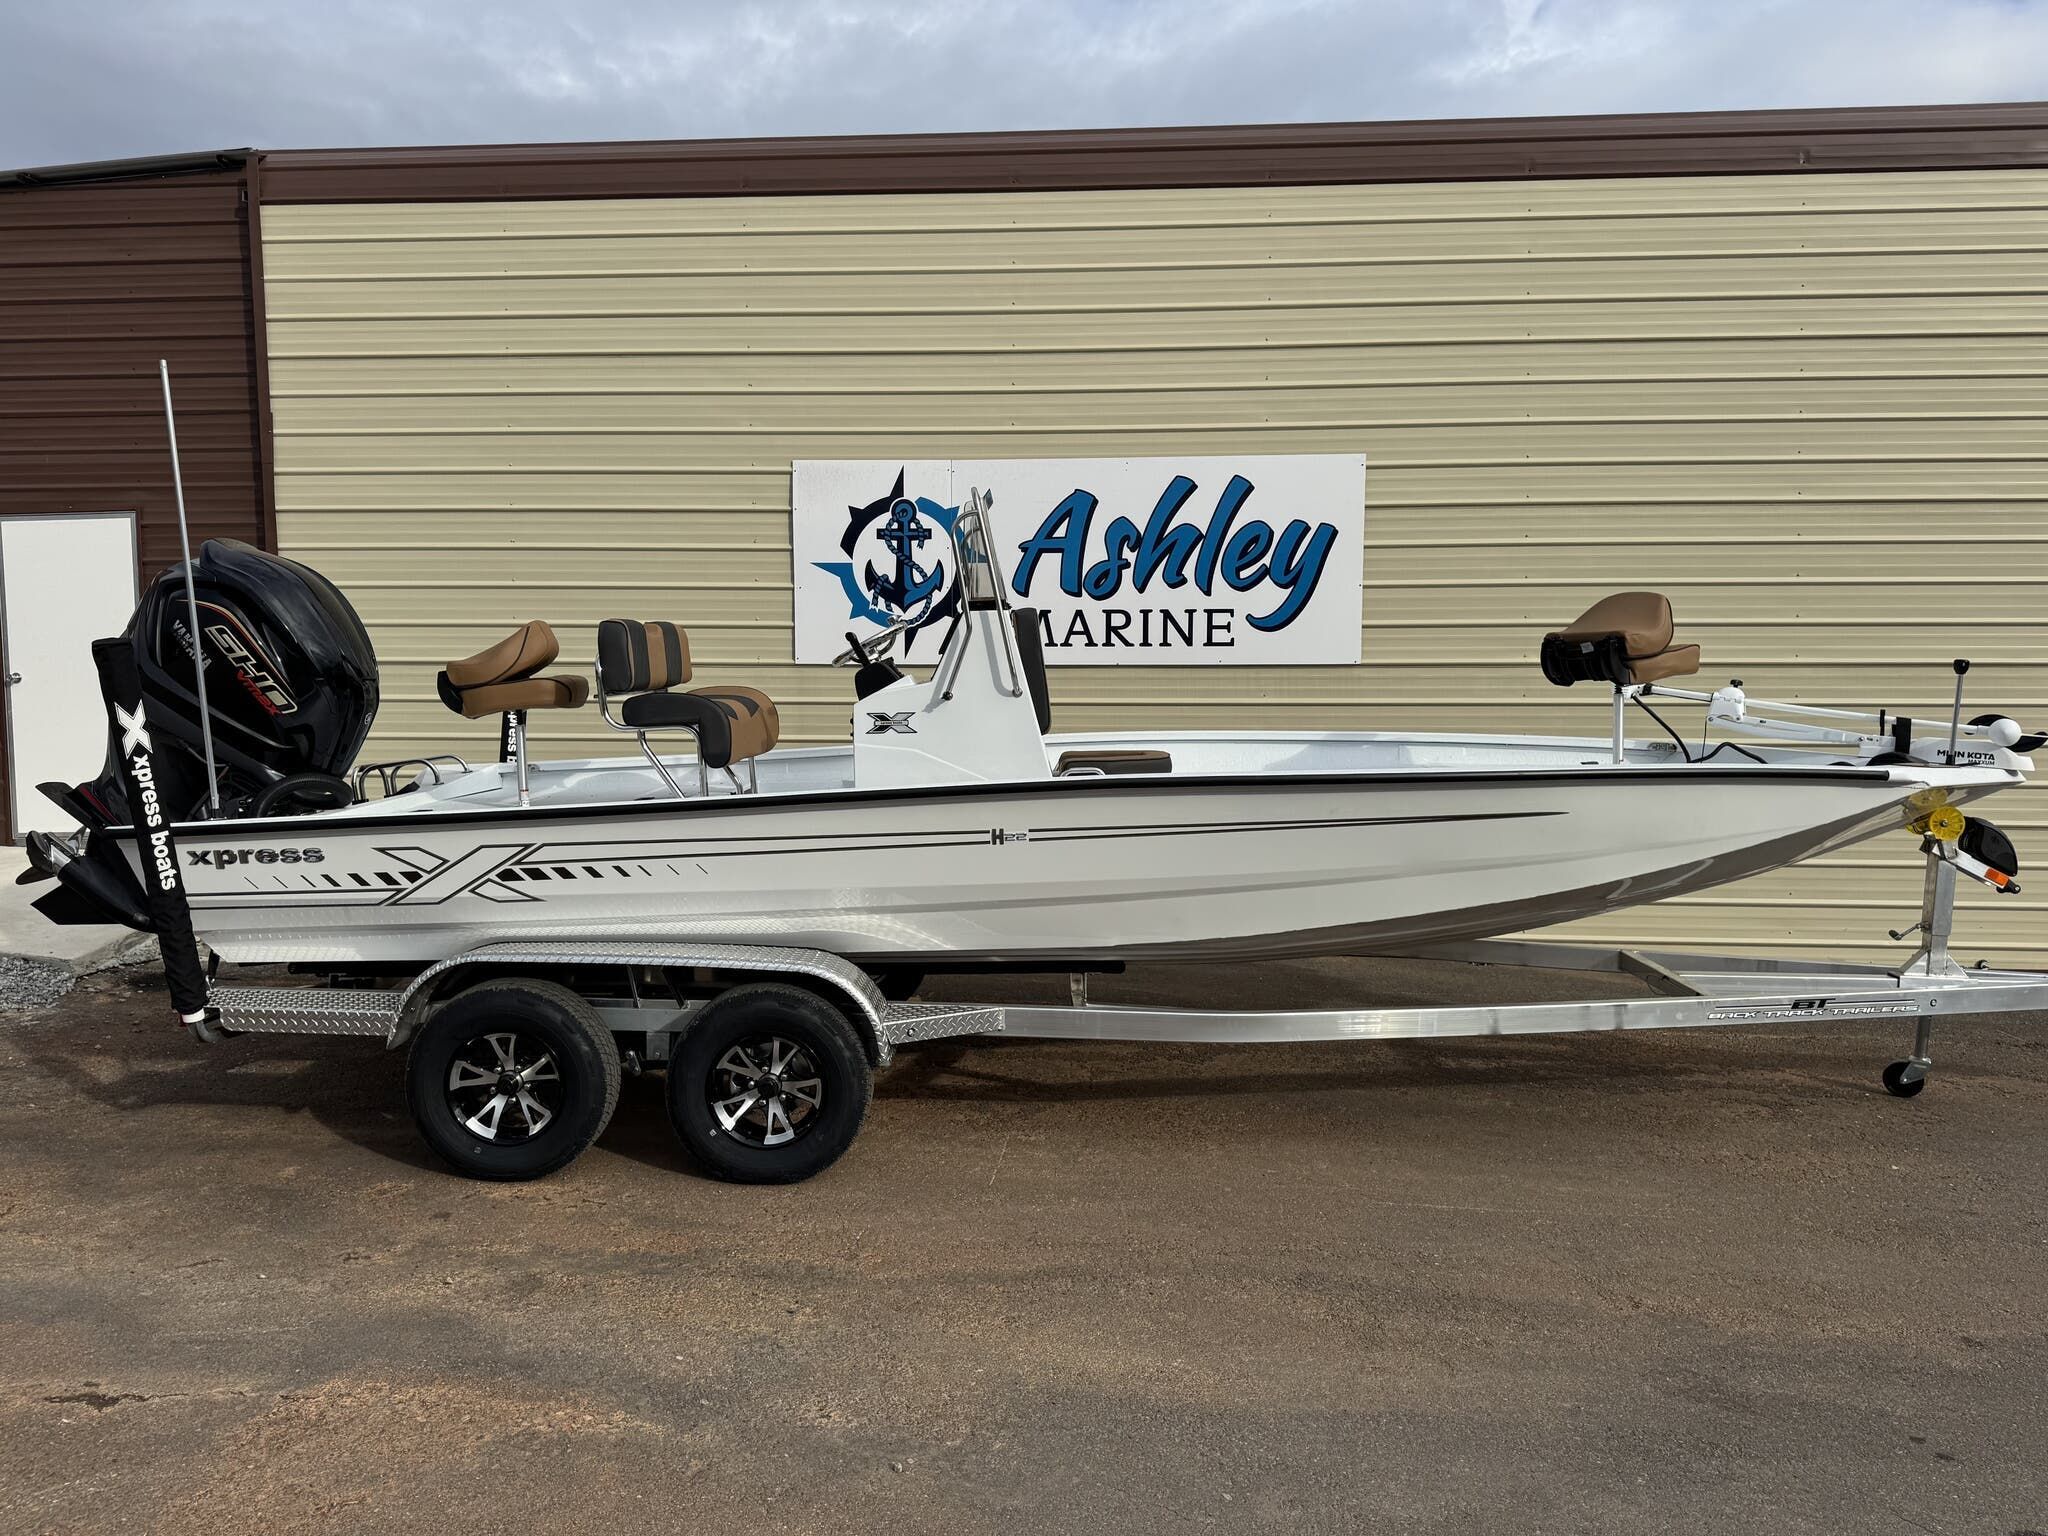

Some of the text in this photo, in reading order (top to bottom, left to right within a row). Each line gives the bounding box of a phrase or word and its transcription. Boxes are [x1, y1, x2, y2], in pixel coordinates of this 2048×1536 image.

[1011, 474, 1339, 632] Ashley
[204, 624, 298, 714] SHO
[1967, 751, 1995, 761] KOTA
[131, 753, 178, 891] xpress boats
[991, 828, 1027, 846] H22
[186, 847, 325, 870] xpress
[1707, 1004, 1920, 1020] BACK TRACK TRAILERS
[1790, 997, 1836, 1010] BT
